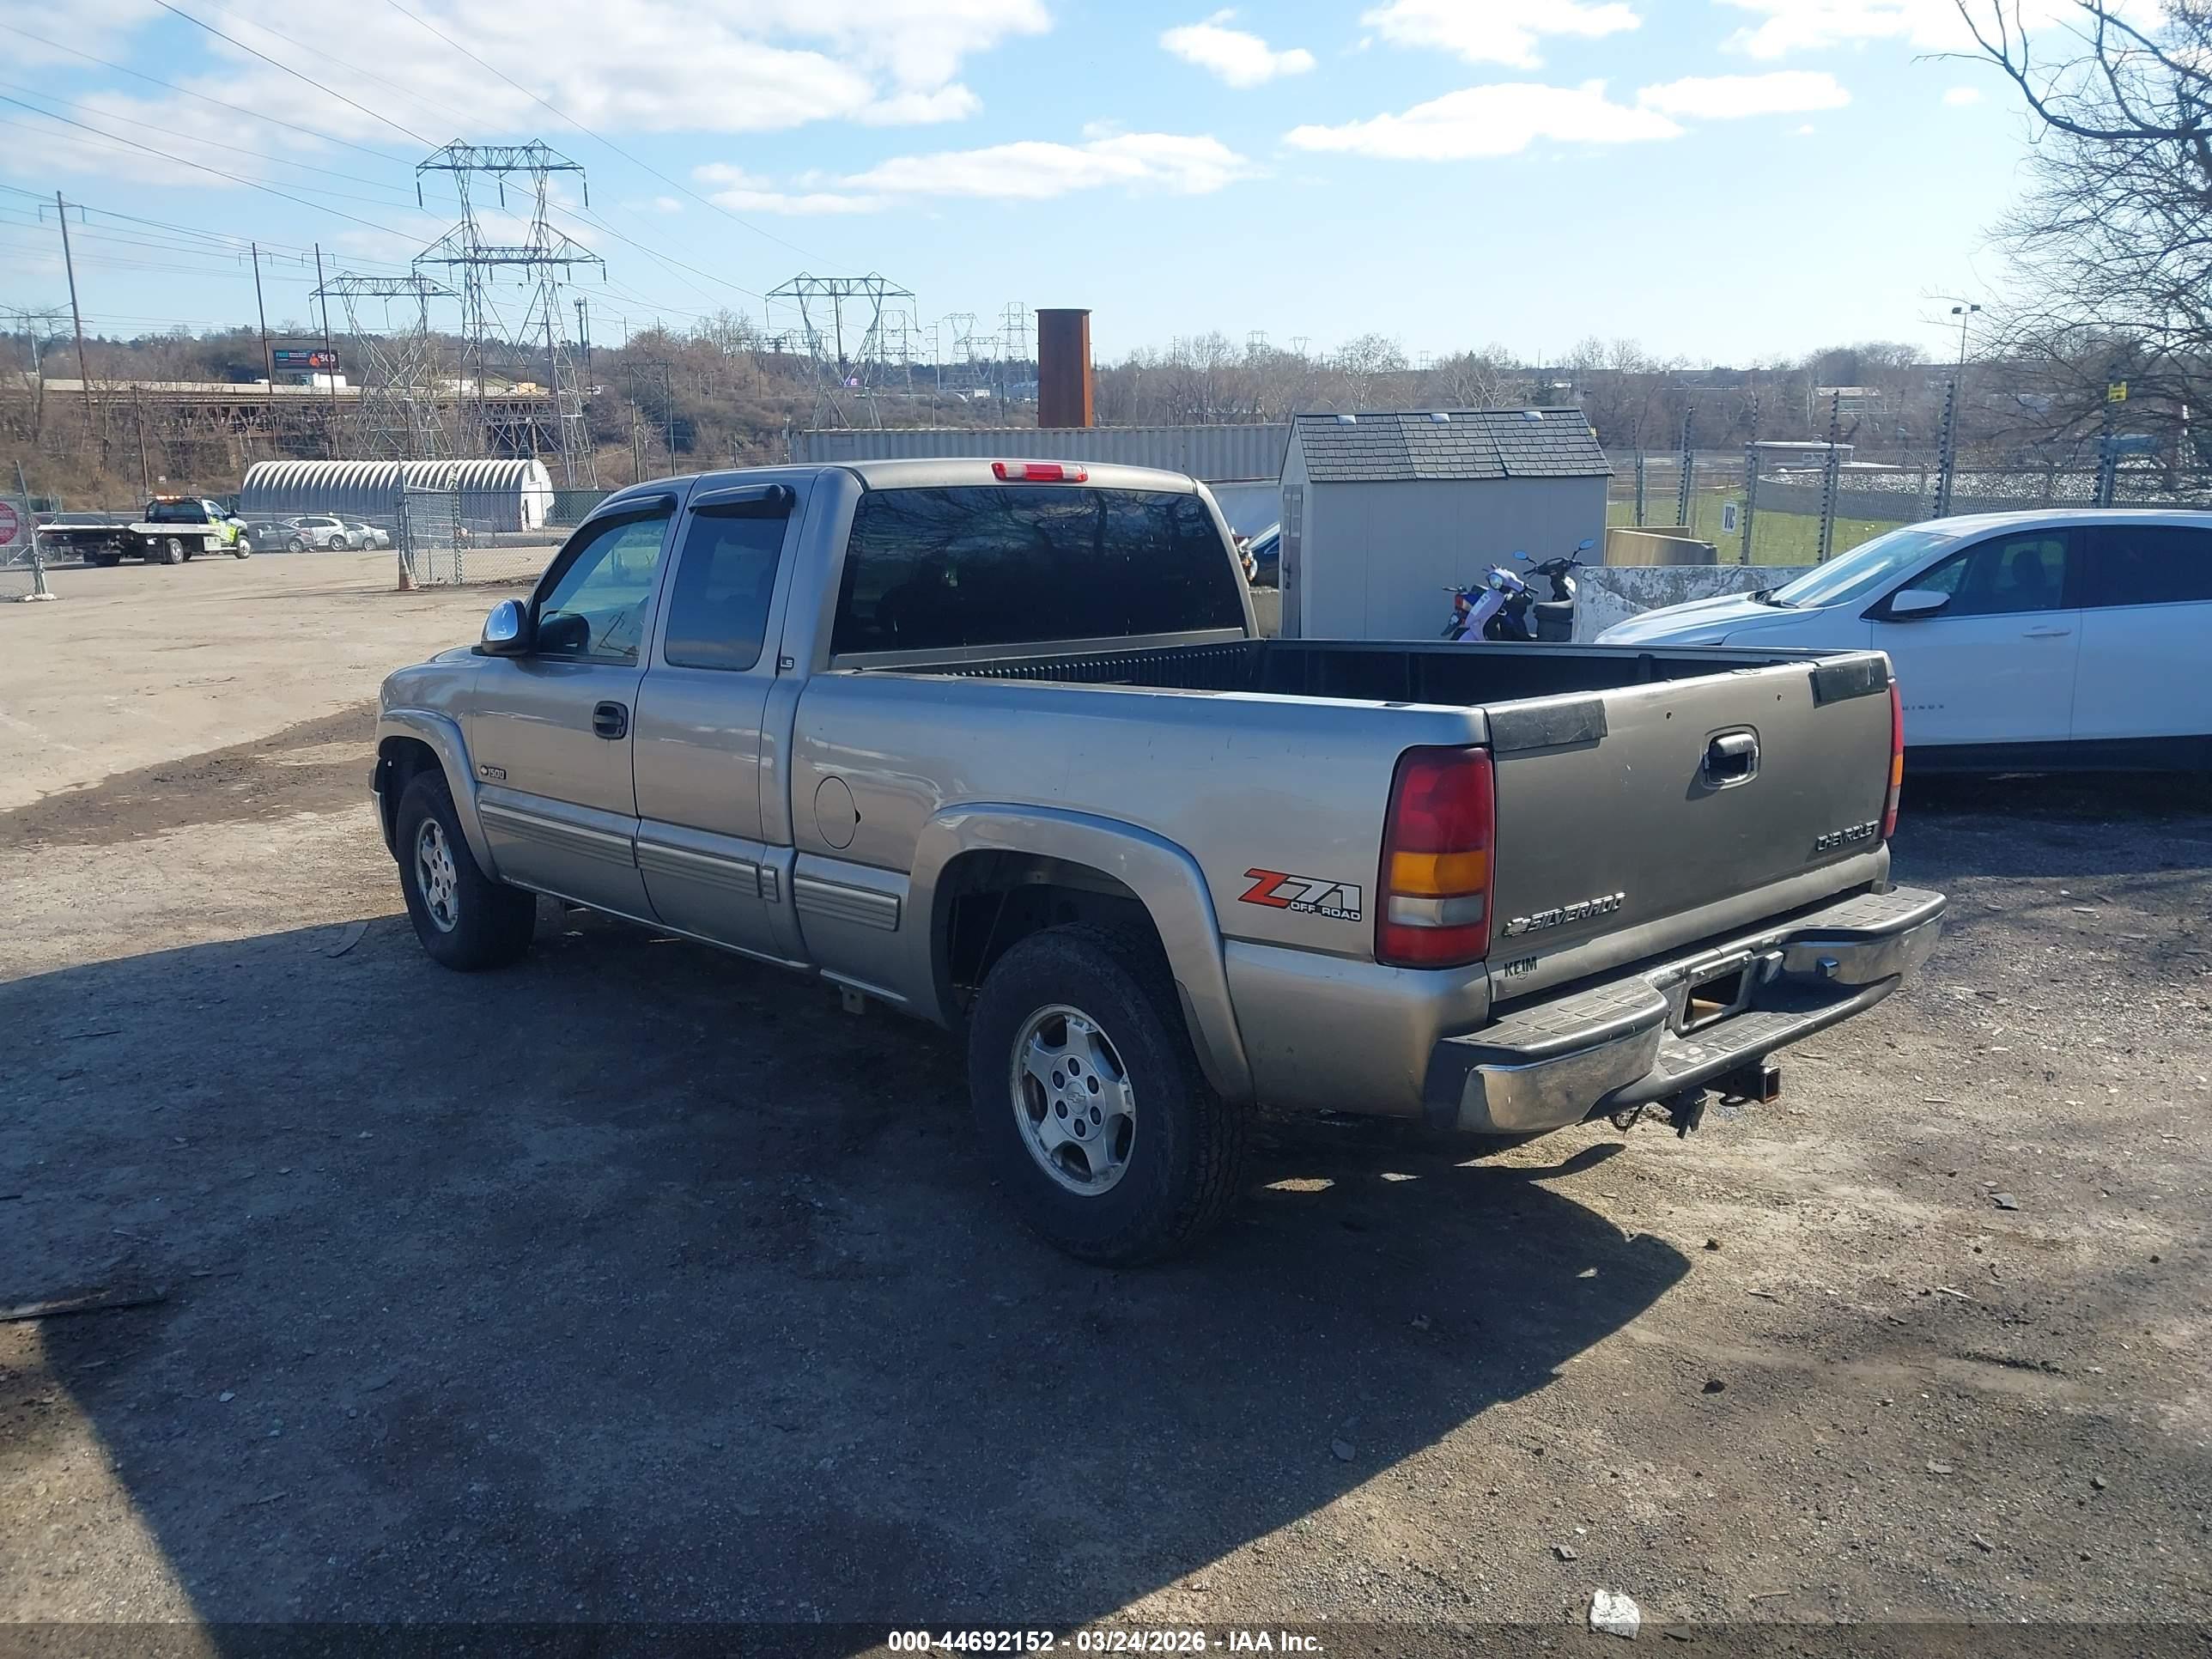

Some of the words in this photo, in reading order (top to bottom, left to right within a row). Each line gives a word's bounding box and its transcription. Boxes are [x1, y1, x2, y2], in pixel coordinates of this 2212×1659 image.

[781, 659, 793, 668] LS
[1815, 819, 1880, 852] CHEVROLET
[1237, 867, 1362, 911] Z71
[1290, 901, 1316, 913] OFF
[1322, 906, 1361, 921] ROAD
[1526, 891, 1626, 933] SILVERADO
[1504, 956, 1538, 978] KEIM
